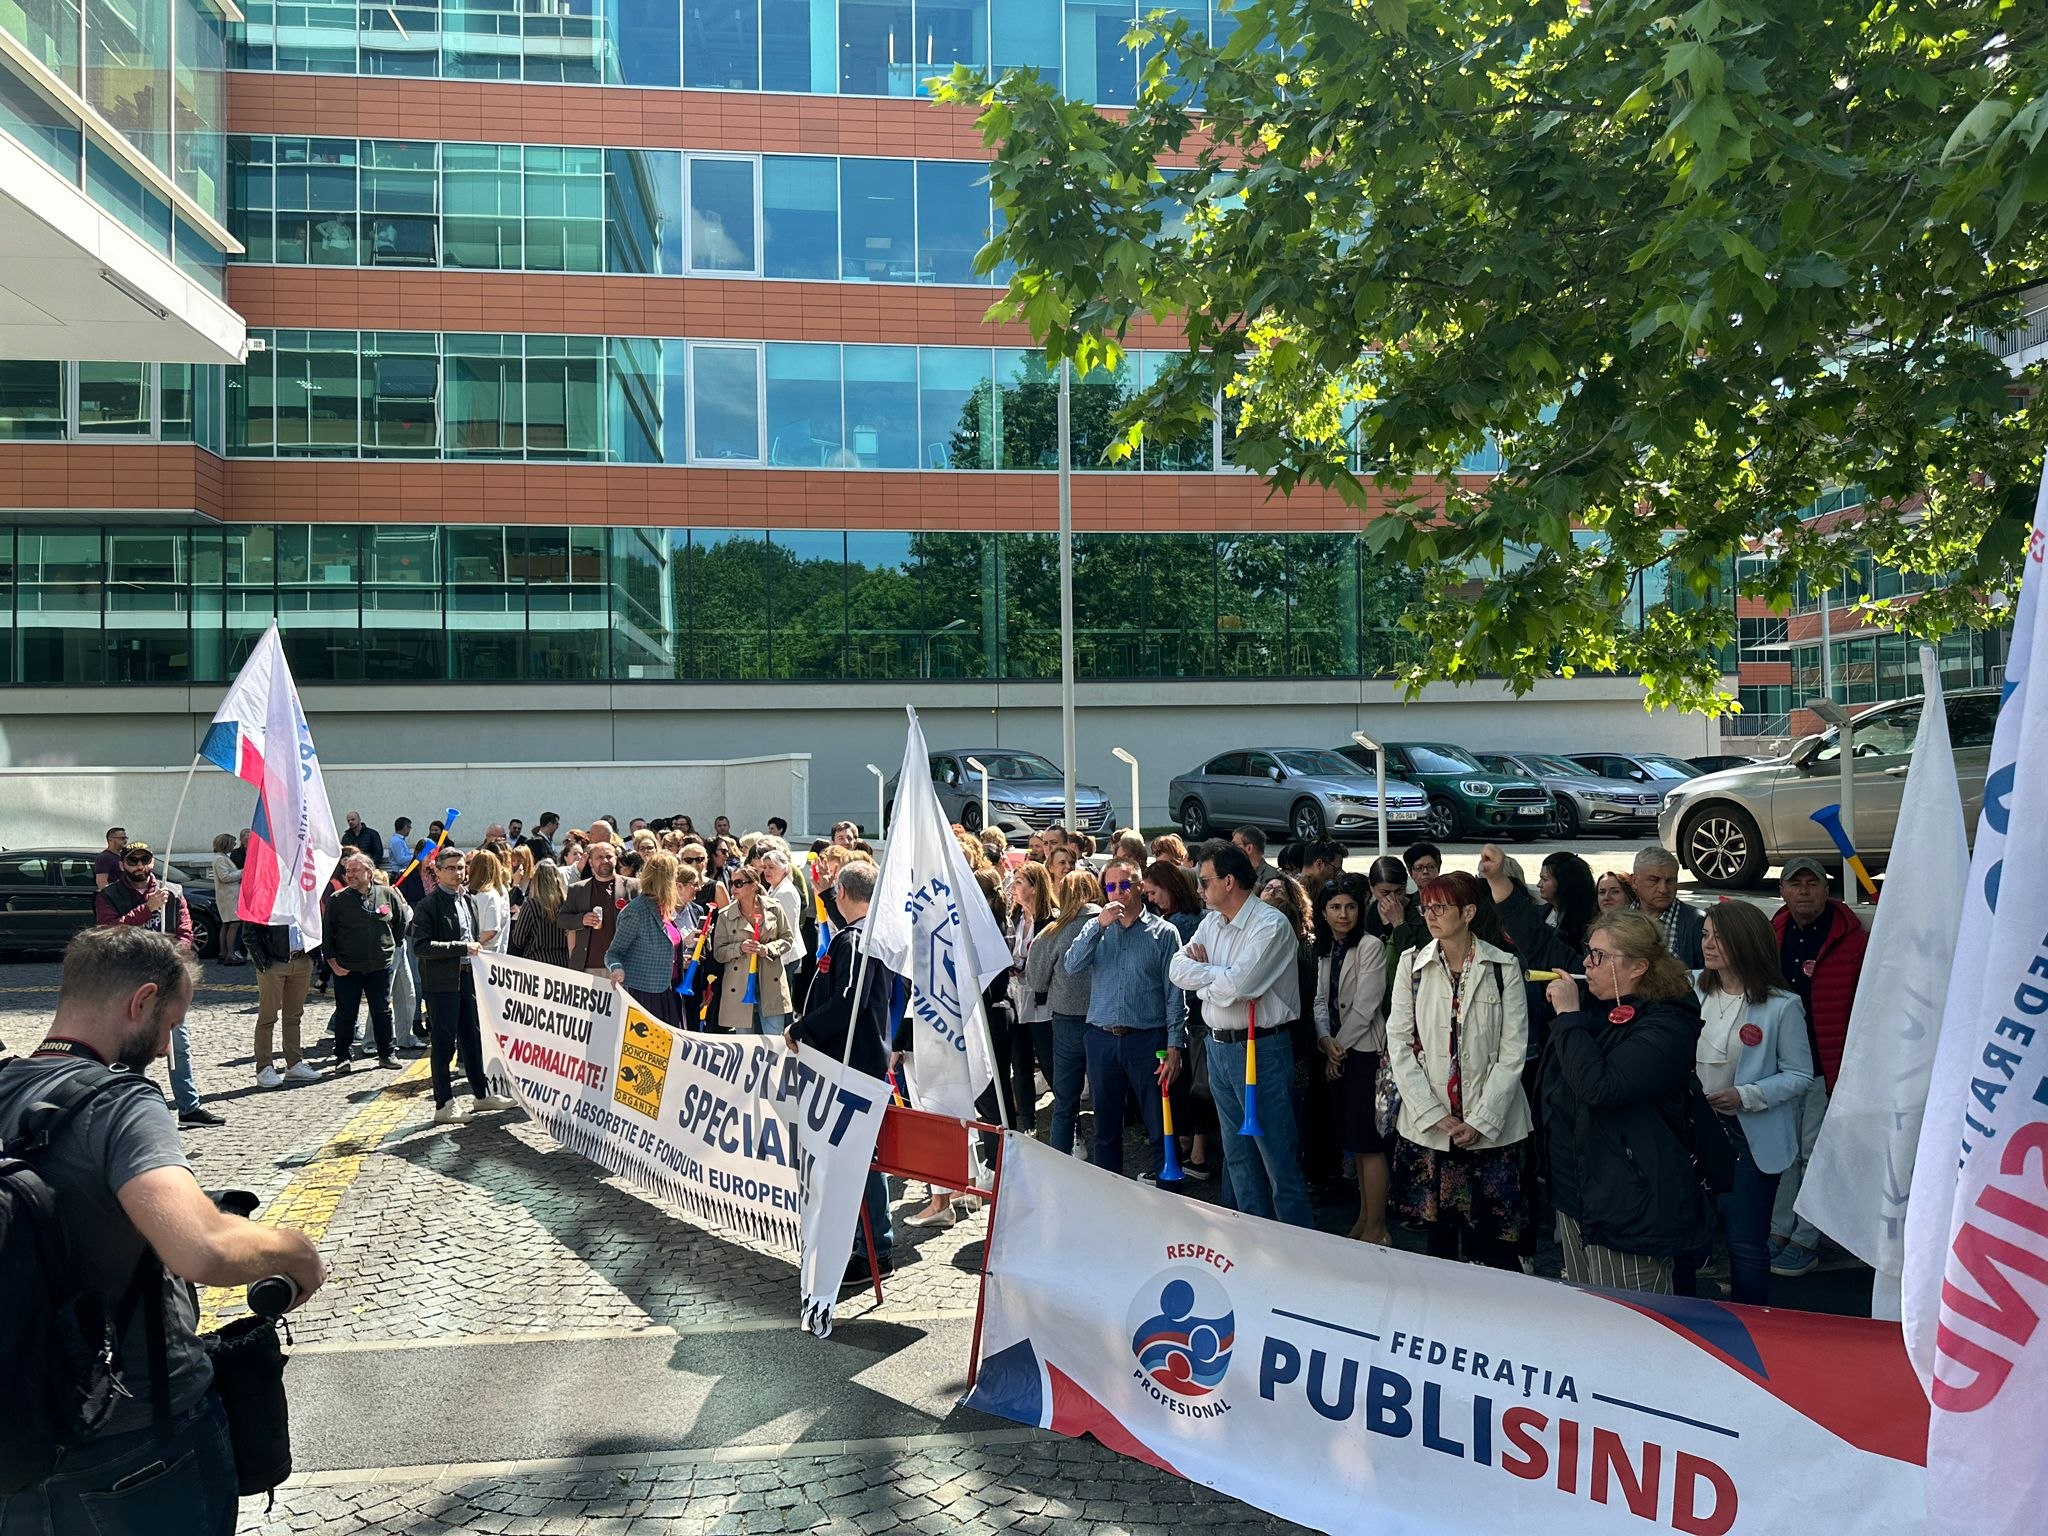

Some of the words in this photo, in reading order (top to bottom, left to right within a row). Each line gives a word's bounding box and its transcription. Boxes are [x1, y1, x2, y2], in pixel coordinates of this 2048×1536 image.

[488, 964, 539, 997] SUSTINE
[543, 978, 612, 1017] DEMERSUL
[37, 1042, 72, 1051] anon
[502, 998, 593, 1045] SINDICATULUI
[508, 1038, 608, 1092] NORMALITATE!
[623, 1045, 633, 1055] DO
[634, 1049, 649, 1060] NOT
[648, 1053, 668, 1068] PANIC
[616, 1090, 658, 1116] ORGANIZE
[677, 1036, 744, 1085] VREM
[744, 1046, 872, 1147] STATUT
[562, 1094, 571, 1111] O
[638, 1129, 656, 1154] DE
[654, 1139, 703, 1184] FONDURI
[1166, 1243, 1234, 1273] RESPECT
[1133, 1369, 1232, 1419] PROFESIONAL
[1260, 1336, 1739, 1536] PUBLISIND
